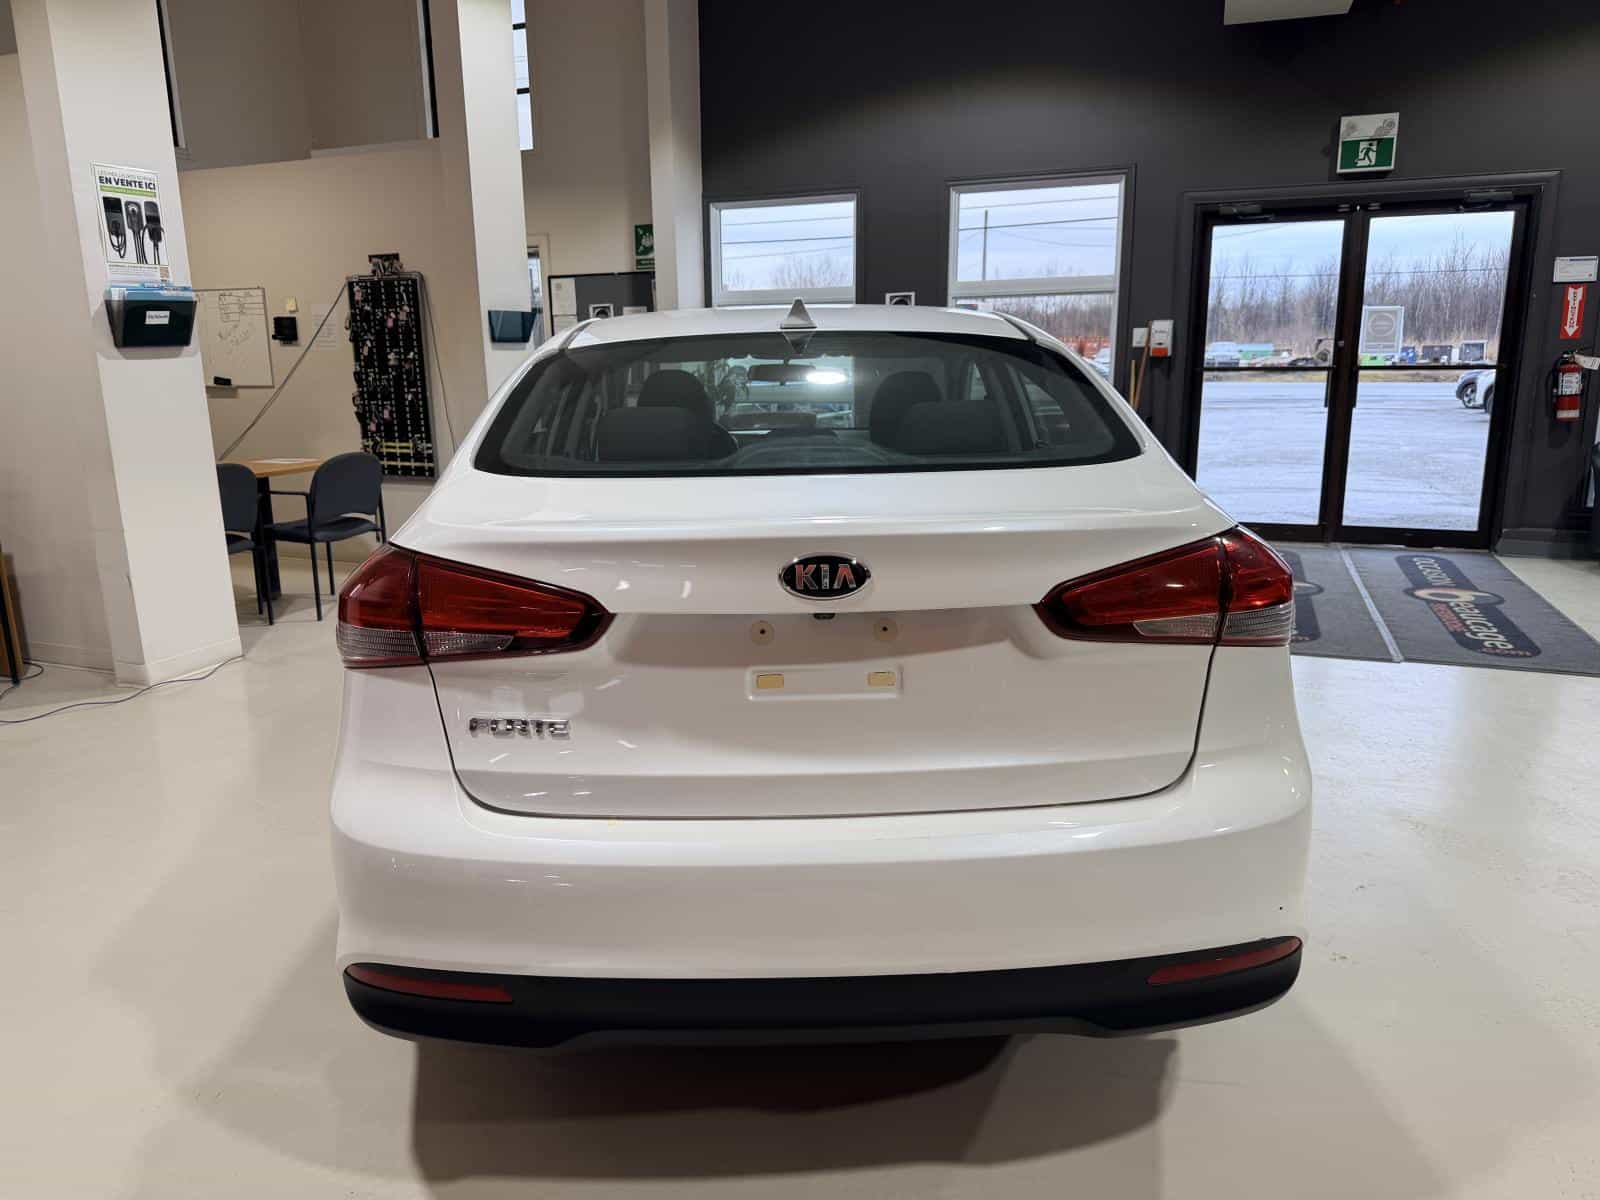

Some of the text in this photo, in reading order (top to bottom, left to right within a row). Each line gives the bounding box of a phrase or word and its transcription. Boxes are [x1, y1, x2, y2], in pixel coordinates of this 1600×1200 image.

[98, 175, 156, 190] EN VENTE ICI
[794, 563, 857, 590] KIA
[469, 717, 570, 736] FORTE
